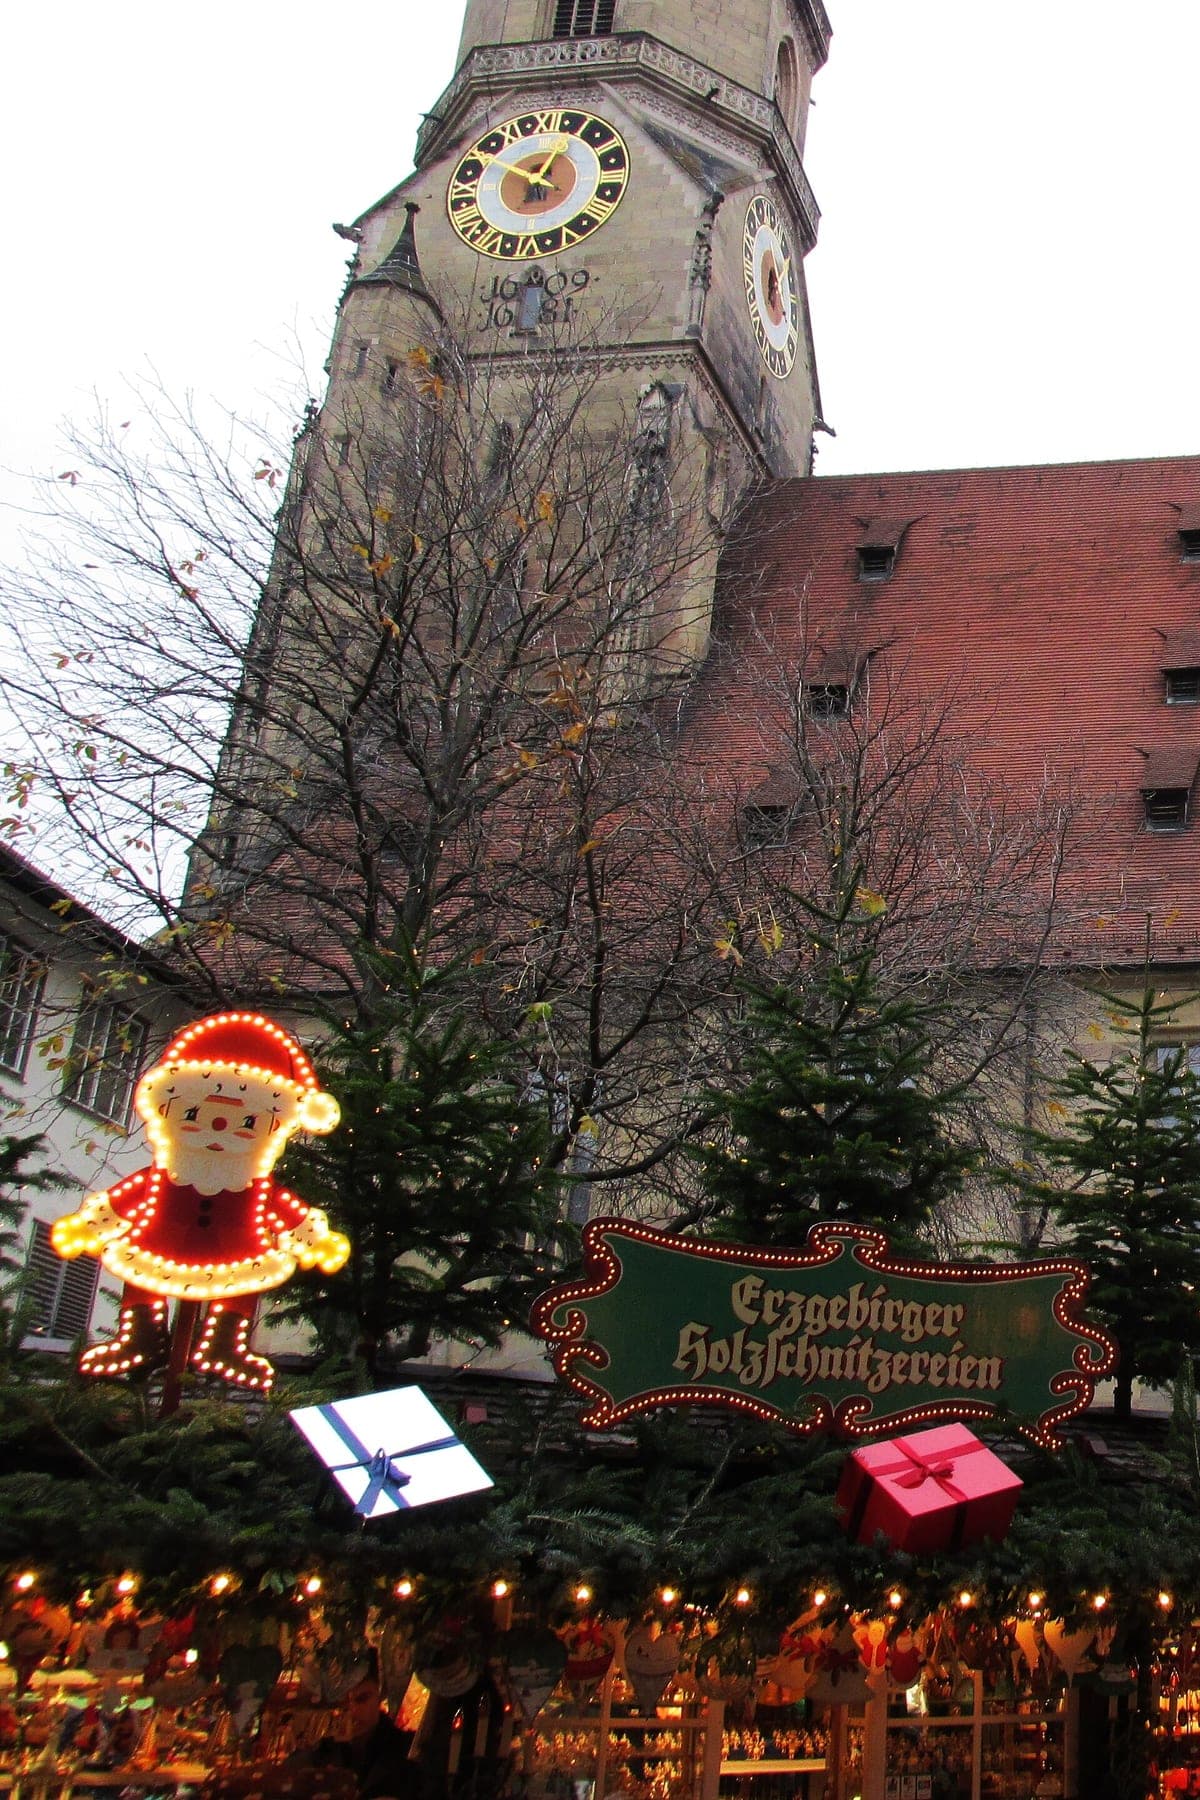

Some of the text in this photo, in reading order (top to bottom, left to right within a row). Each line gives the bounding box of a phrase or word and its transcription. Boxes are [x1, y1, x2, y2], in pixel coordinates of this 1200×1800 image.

[533, 111, 565, 133] XII
[575, 117, 594, 137] I
[498, 123, 523, 145] XI
[595, 137, 621, 156] II
[600, 168, 625, 184] III
[452, 179, 478, 200] IX
[584, 196, 613, 221] IIII
[453, 204, 483, 240] VIII
[473, 226, 503, 255] VII
[513, 234, 542, 257] VI
[561, 226, 582, 247] V
[731, 1274, 965, 1343] Erzgebirger
